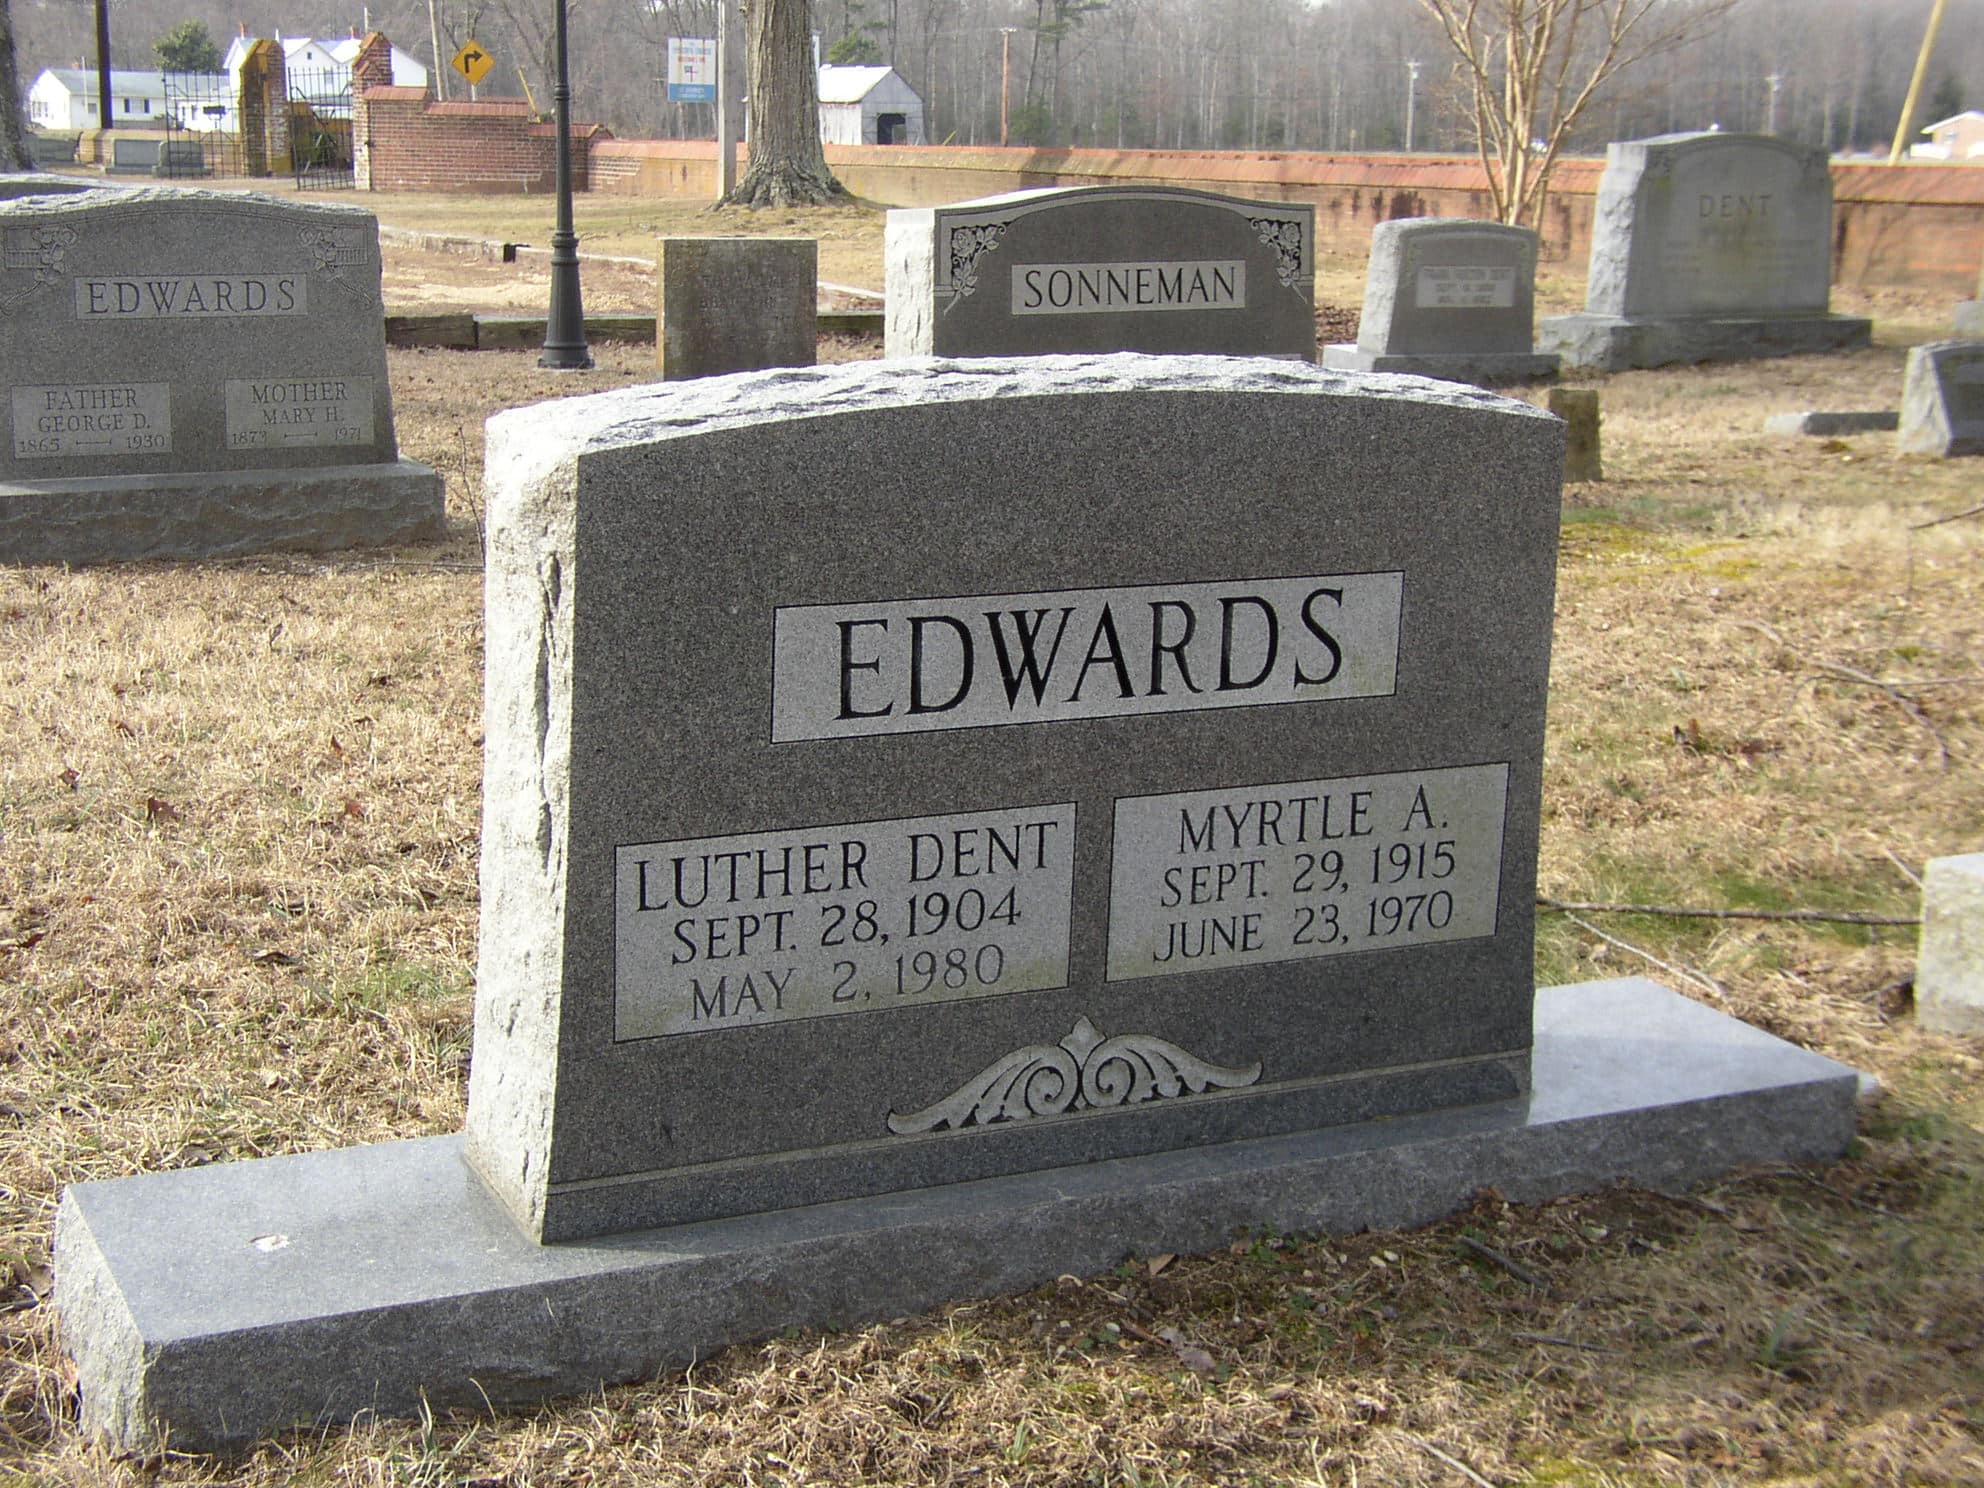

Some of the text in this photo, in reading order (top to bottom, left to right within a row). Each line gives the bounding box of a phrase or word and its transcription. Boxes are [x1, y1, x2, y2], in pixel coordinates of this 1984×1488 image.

[1699, 193, 1773, 218] DENT
[85, 279, 296, 315] EDWARDS
[1024, 265, 1236, 308] SONNEMAN
[44, 388, 139, 411] FATHER
[251, 381, 349, 404] MOTHER
[38, 412, 151, 433] GEORGE D.
[262, 408, 316, 425] MARY
[126, 433, 166, 449] 1930
[833, 587, 1345, 721] EDWARDS
[1177, 783, 1449, 855] MYRTLE A.
[633, 820, 1059, 913] LUTHER DENT
[1160, 839, 1457, 908] SEPT. 29, 1915
[671, 885, 1023, 966] SEPT. 28, 1904
[1152, 889, 1454, 963] JUNE 23, 1970
[689, 943, 1005, 1022] MAY 2, 1980
